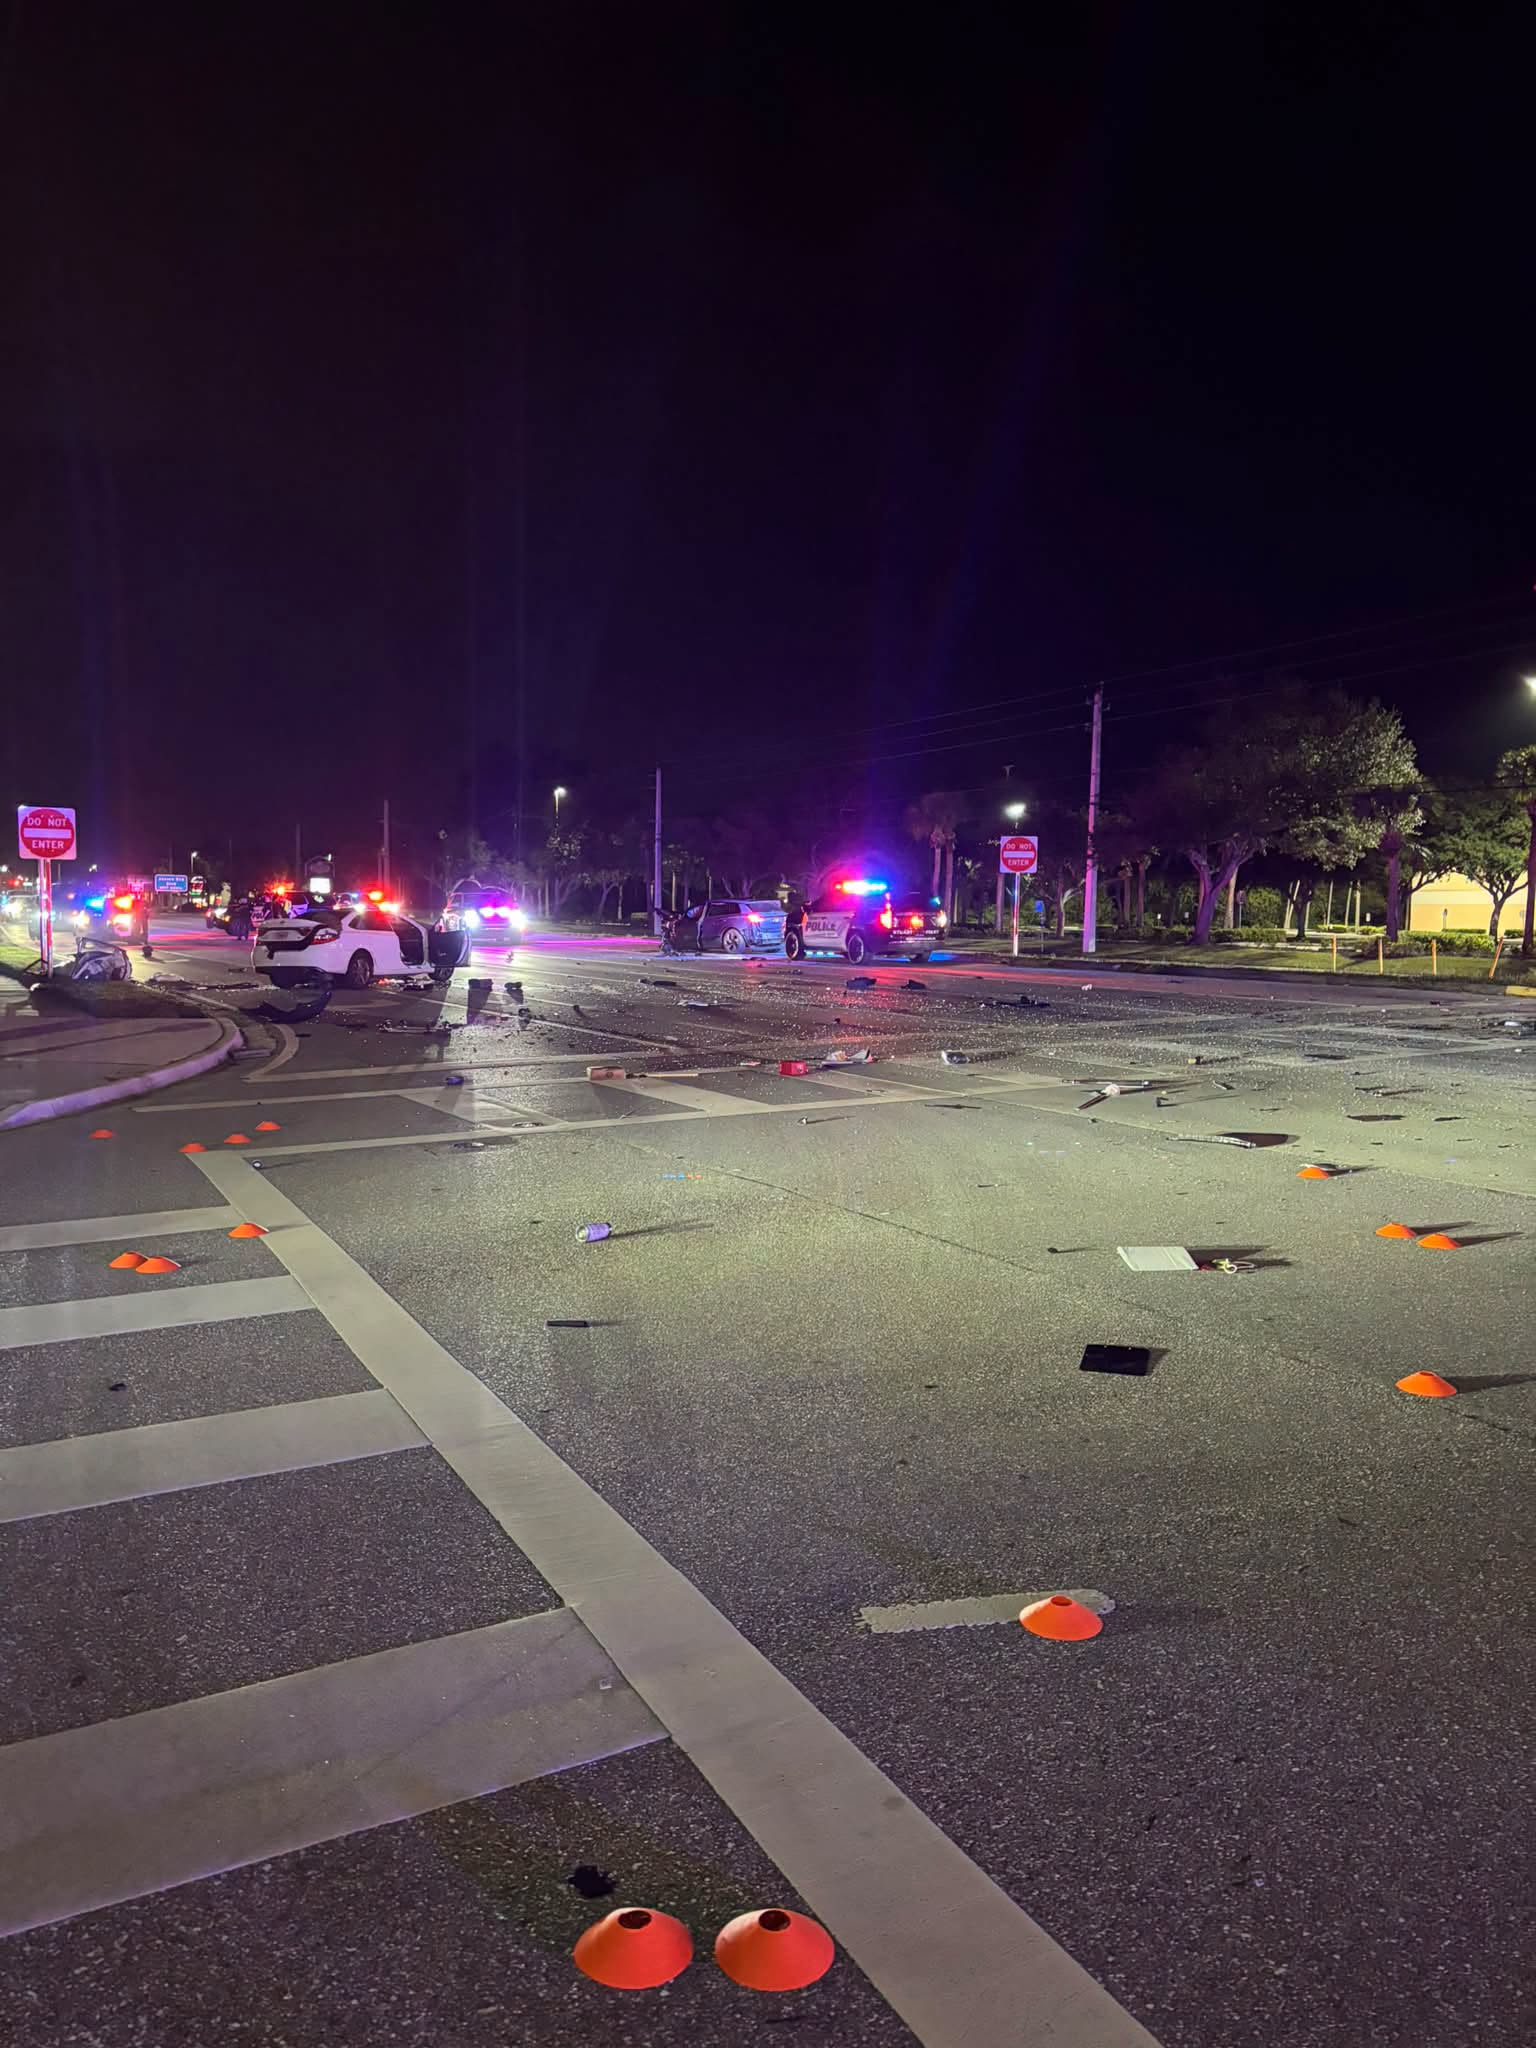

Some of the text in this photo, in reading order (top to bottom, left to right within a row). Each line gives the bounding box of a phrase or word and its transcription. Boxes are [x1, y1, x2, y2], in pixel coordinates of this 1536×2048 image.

[27, 818, 66, 827] DO NOT
[32, 840, 64, 849] ENTER
[806, 921, 836, 931] POLICE
